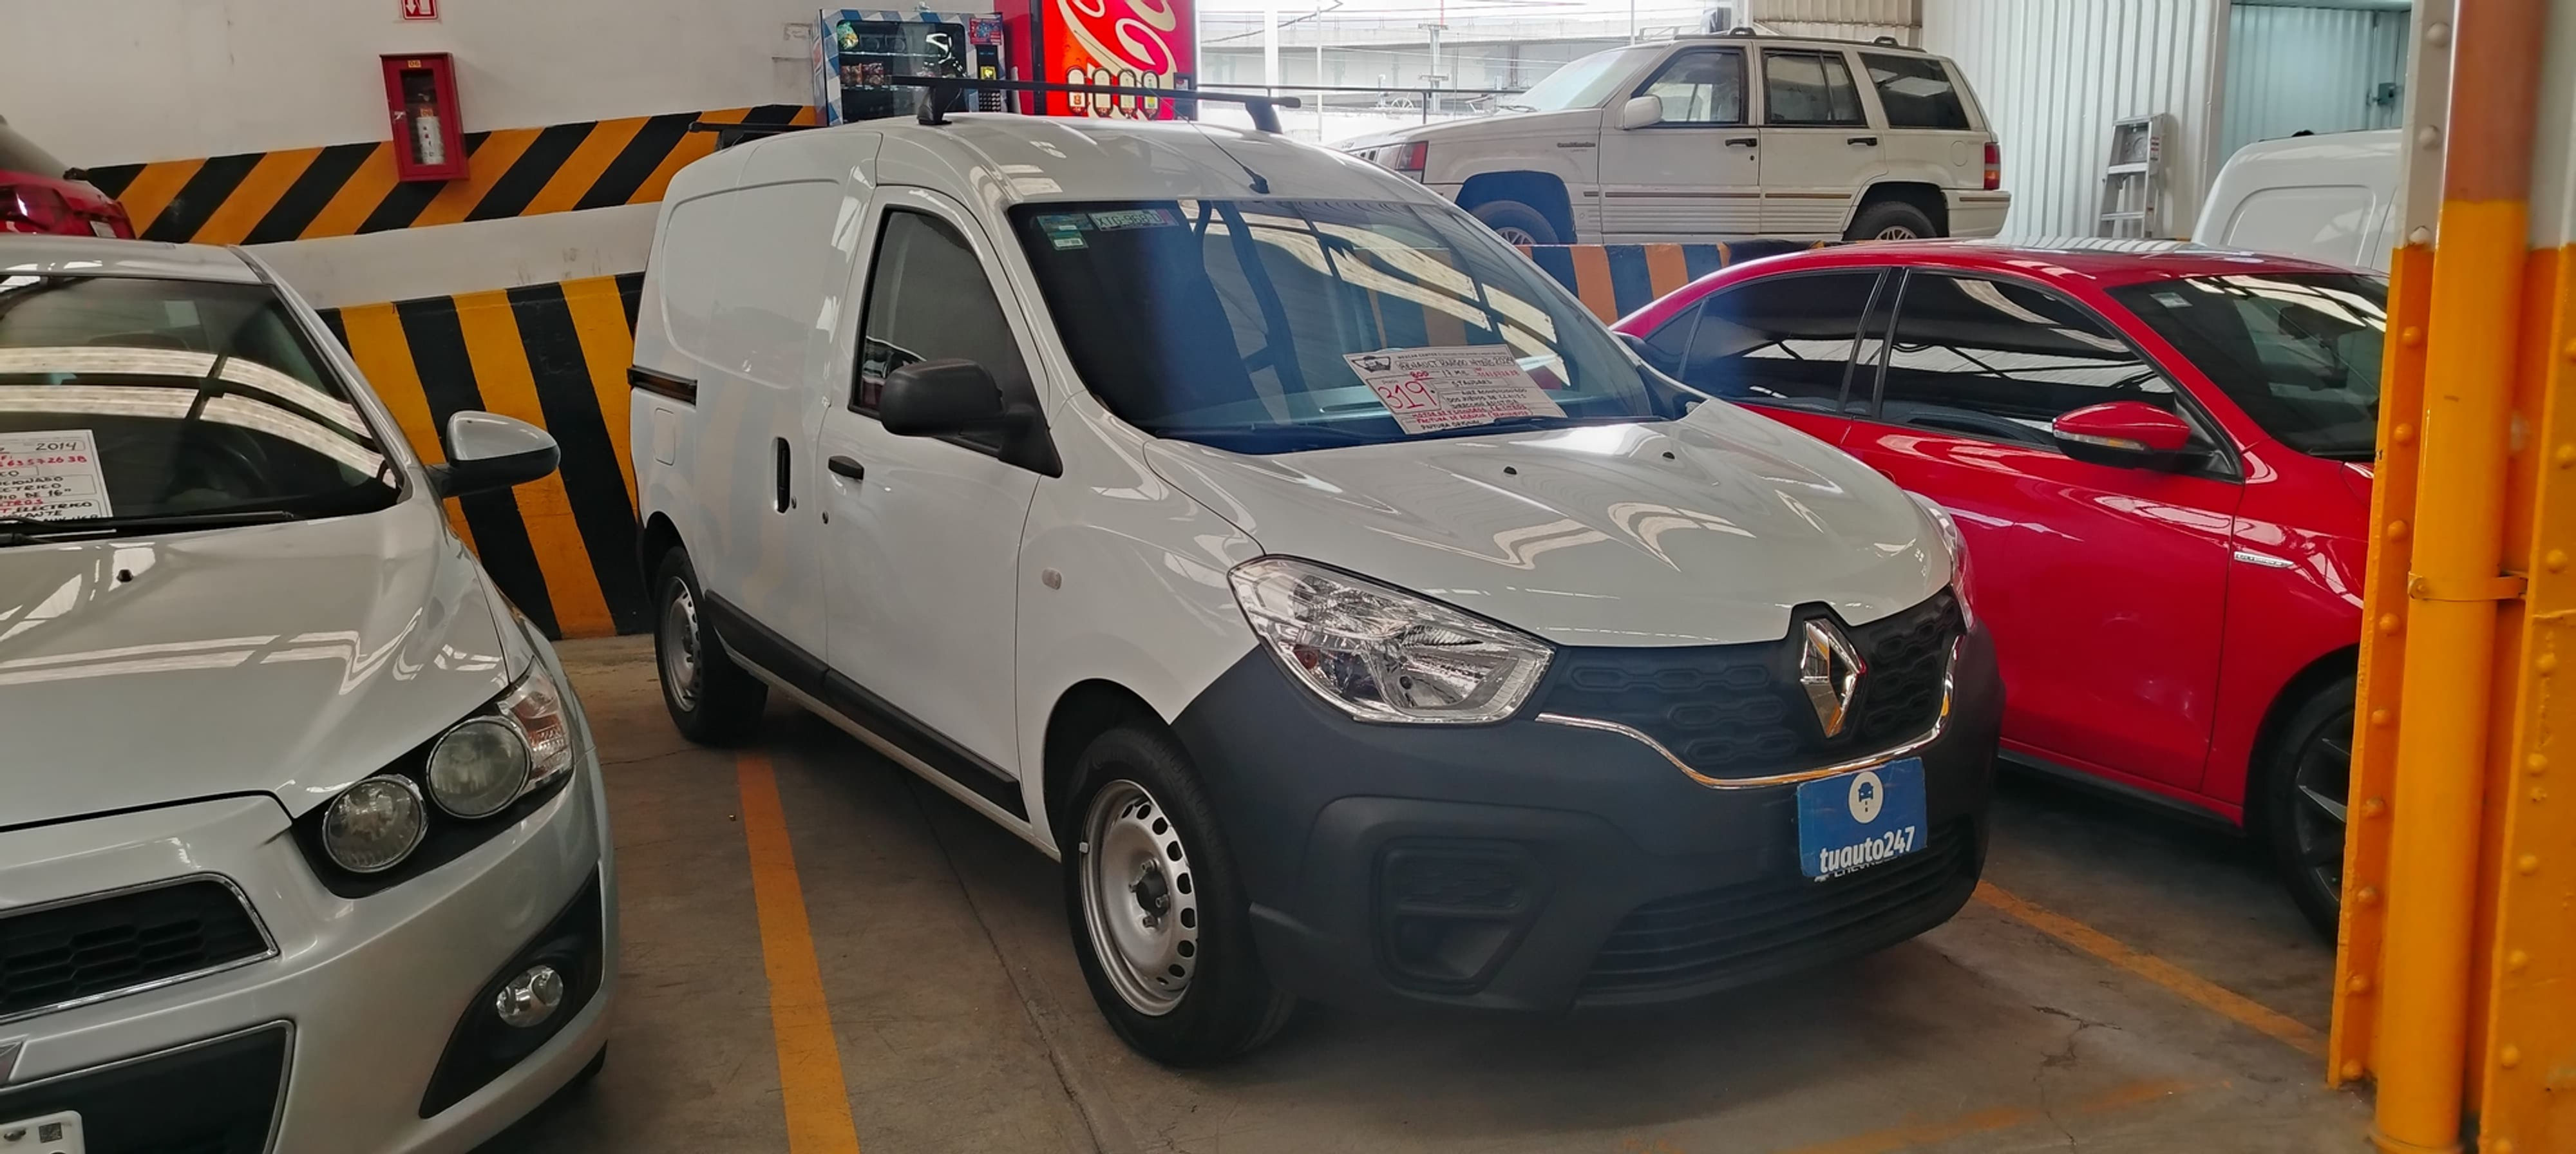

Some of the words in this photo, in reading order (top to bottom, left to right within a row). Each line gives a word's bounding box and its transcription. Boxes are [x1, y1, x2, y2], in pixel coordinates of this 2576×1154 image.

[1378, 381, 1437, 409] 319
[35, 442, 77, 451] 2014
[1819, 826, 1915, 873] tuauto247
